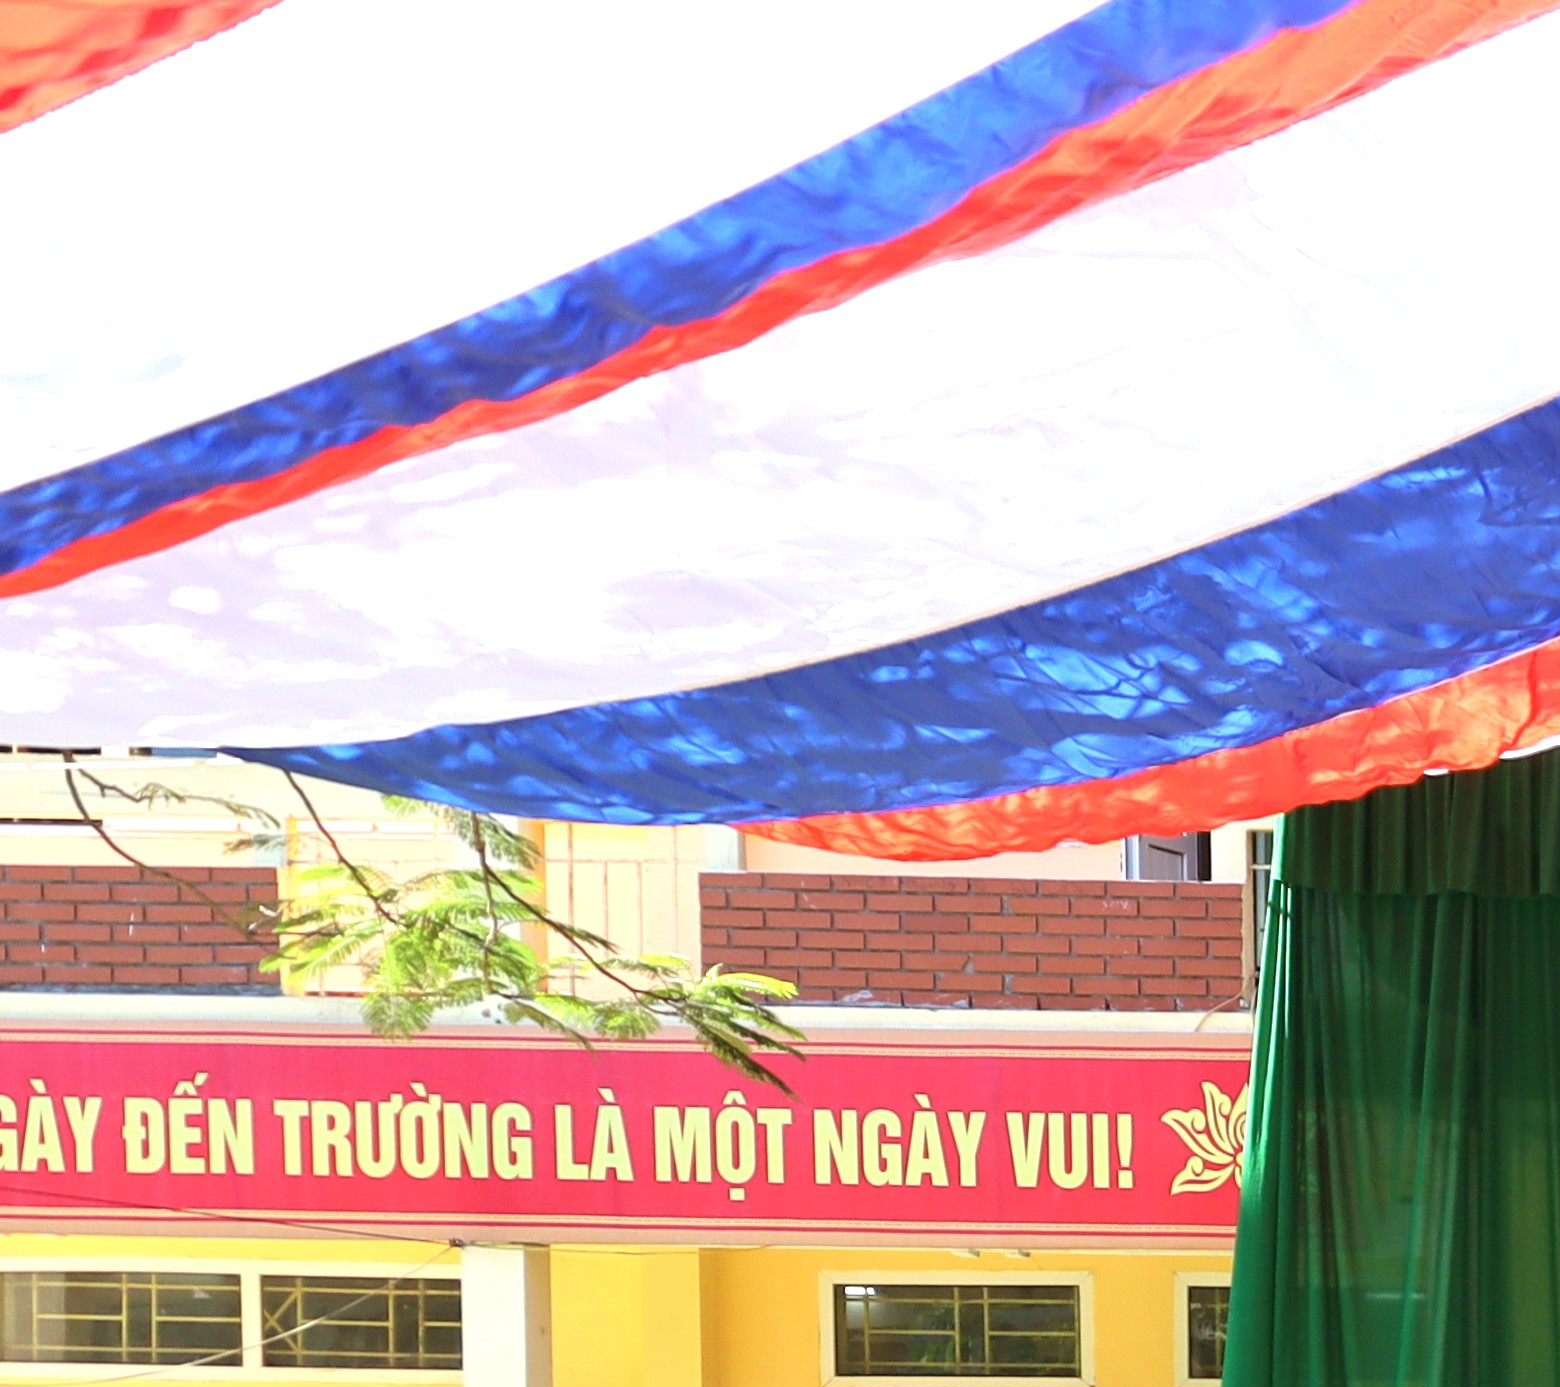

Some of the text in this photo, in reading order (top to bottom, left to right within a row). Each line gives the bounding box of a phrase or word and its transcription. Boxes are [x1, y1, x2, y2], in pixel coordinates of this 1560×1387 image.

[122, 1073, 255, 1174] ĐẾN
[273, 1082, 532, 1180] TRƯỜNG
[556, 1088, 634, 1182] LÀ
[653, 1090, 793, 1200] MỘT
[812, 1094, 986, 1187] NGÀY
[1006, 1112, 1134, 1190] VUI!
